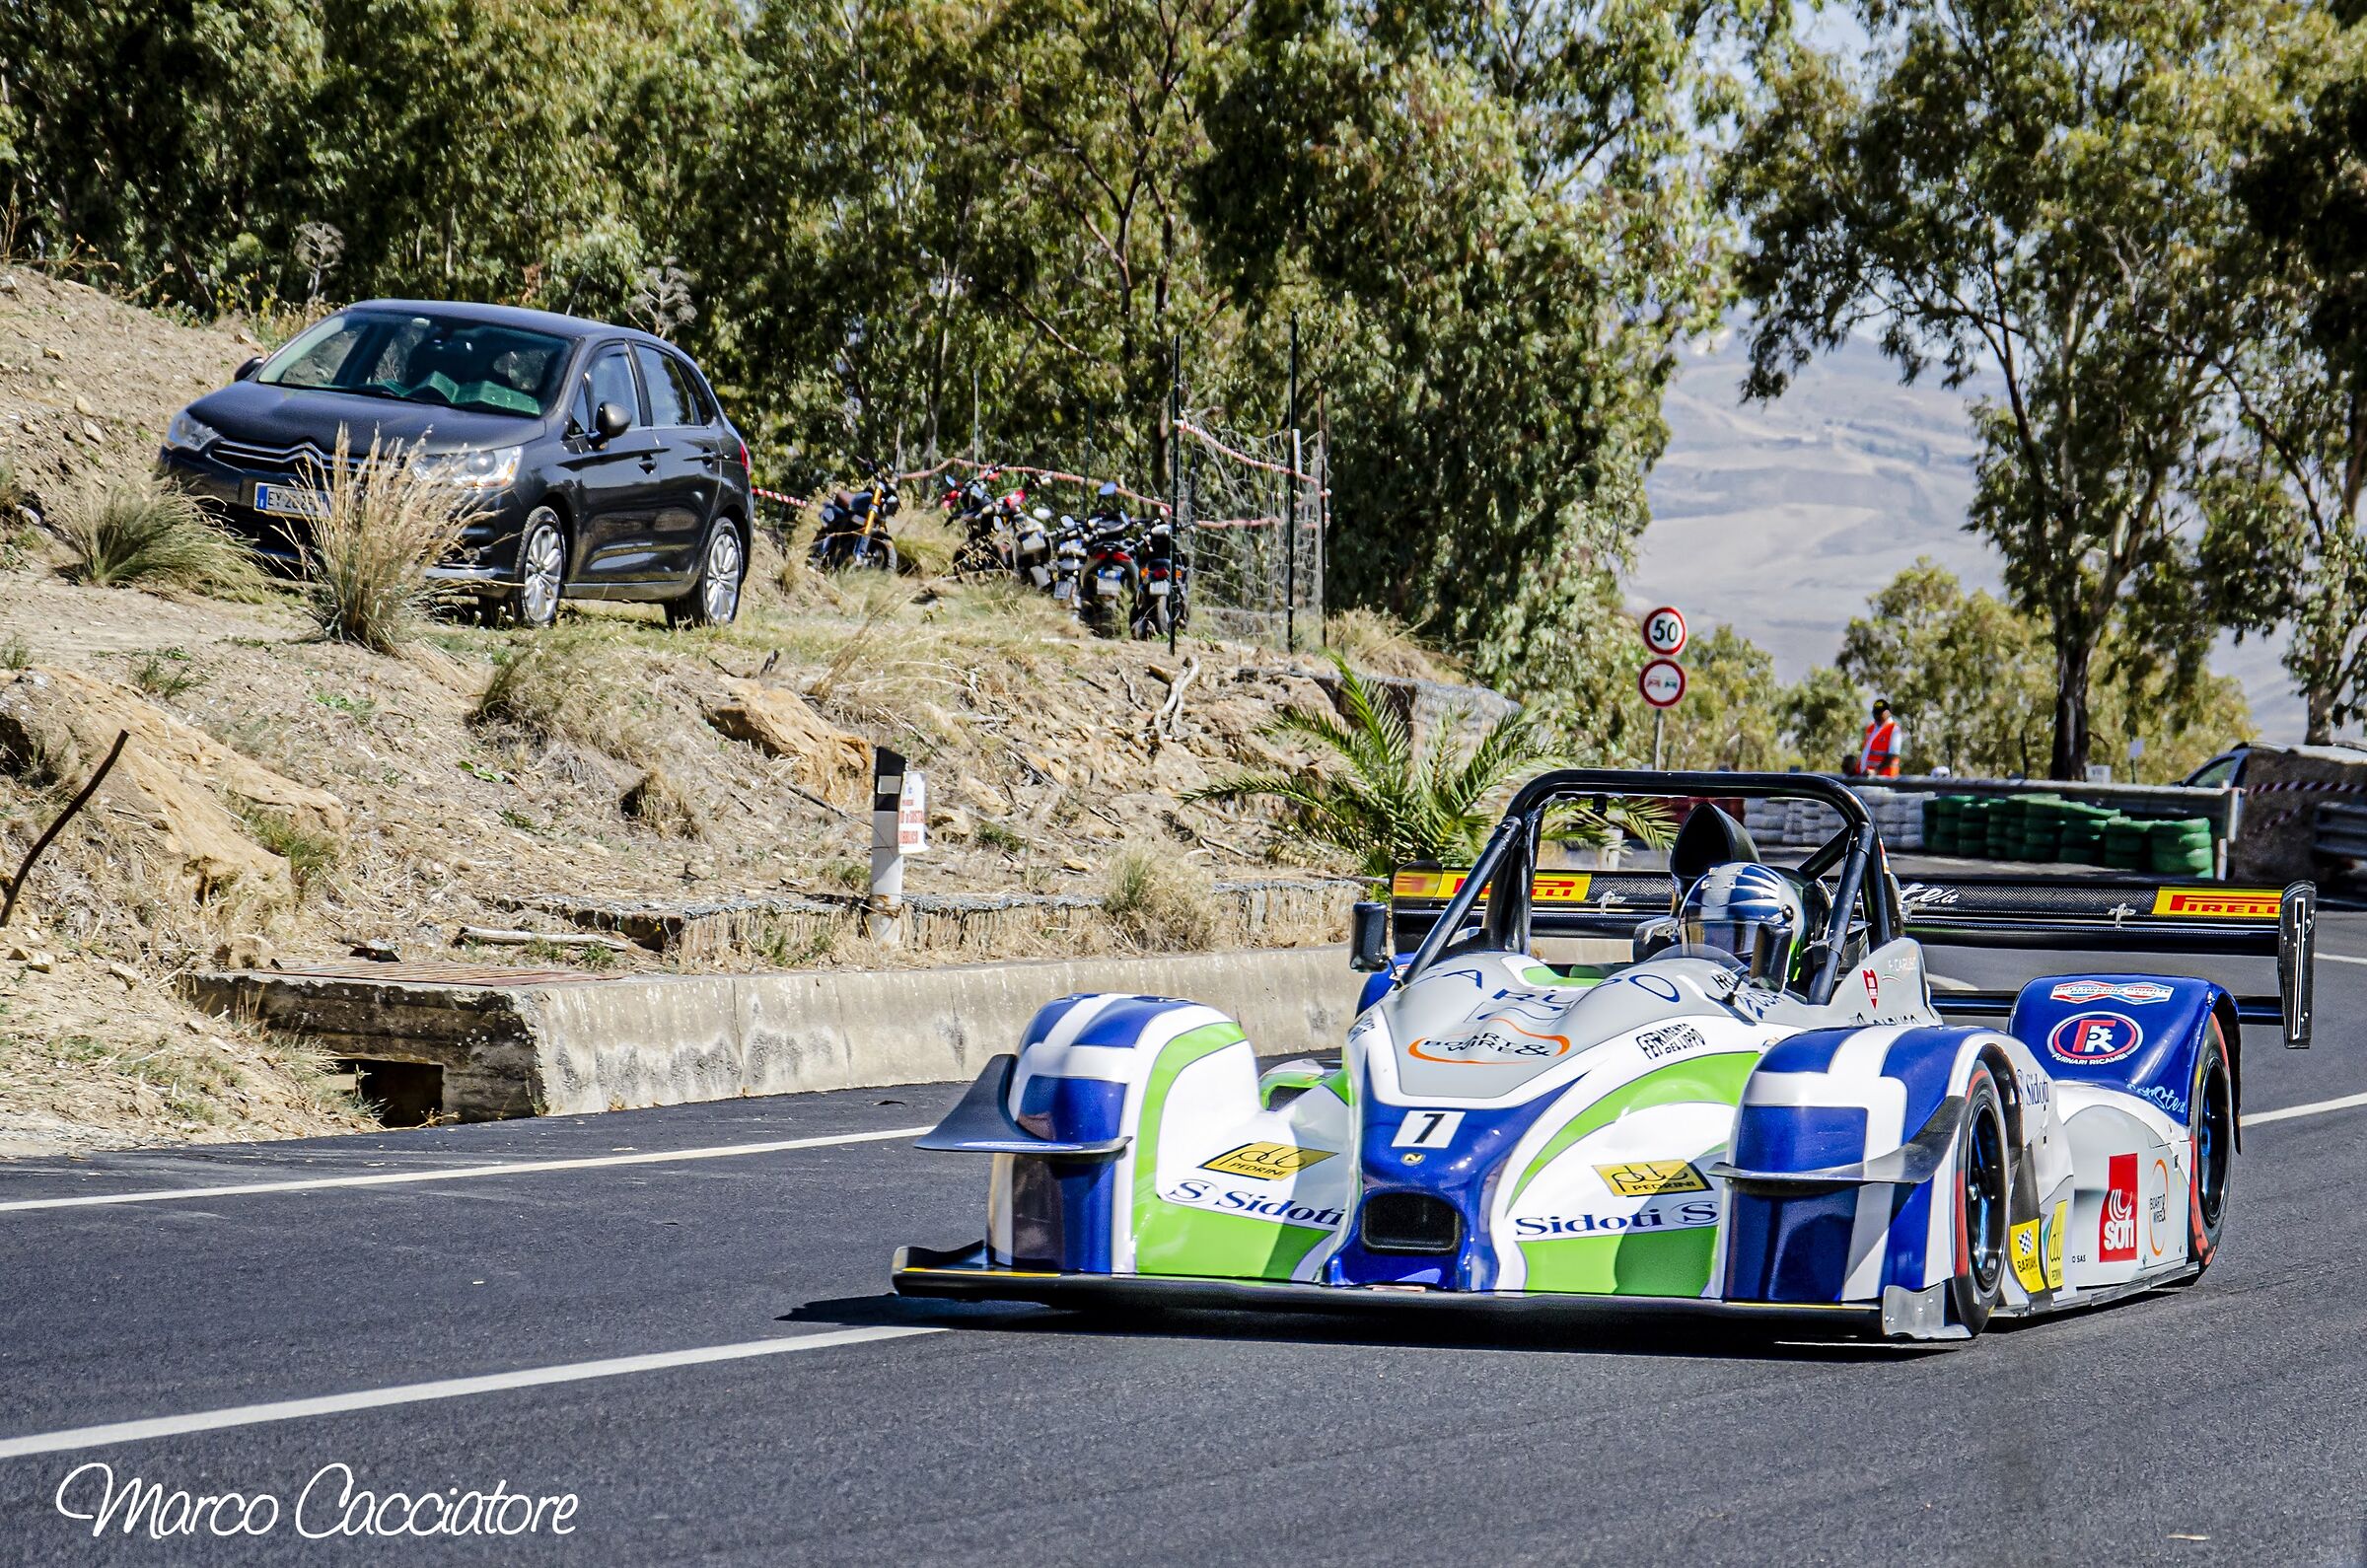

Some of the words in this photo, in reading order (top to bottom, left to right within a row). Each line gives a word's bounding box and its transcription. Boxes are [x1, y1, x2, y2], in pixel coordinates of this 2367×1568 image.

[1652, 619, 1678, 643] 50
[2170, 894, 2281, 914] PIRELL
[2051, 1052, 2088, 1065] FURNARI
[2089, 1052, 2128, 1066] RICAMBI
[1230, 1162, 1287, 1176] PEDRINI
[1632, 1181, 1697, 1191] PEDRINI
[1214, 1190, 1346, 1226] Sidoti
[1515, 1209, 1664, 1236] Sidoti
